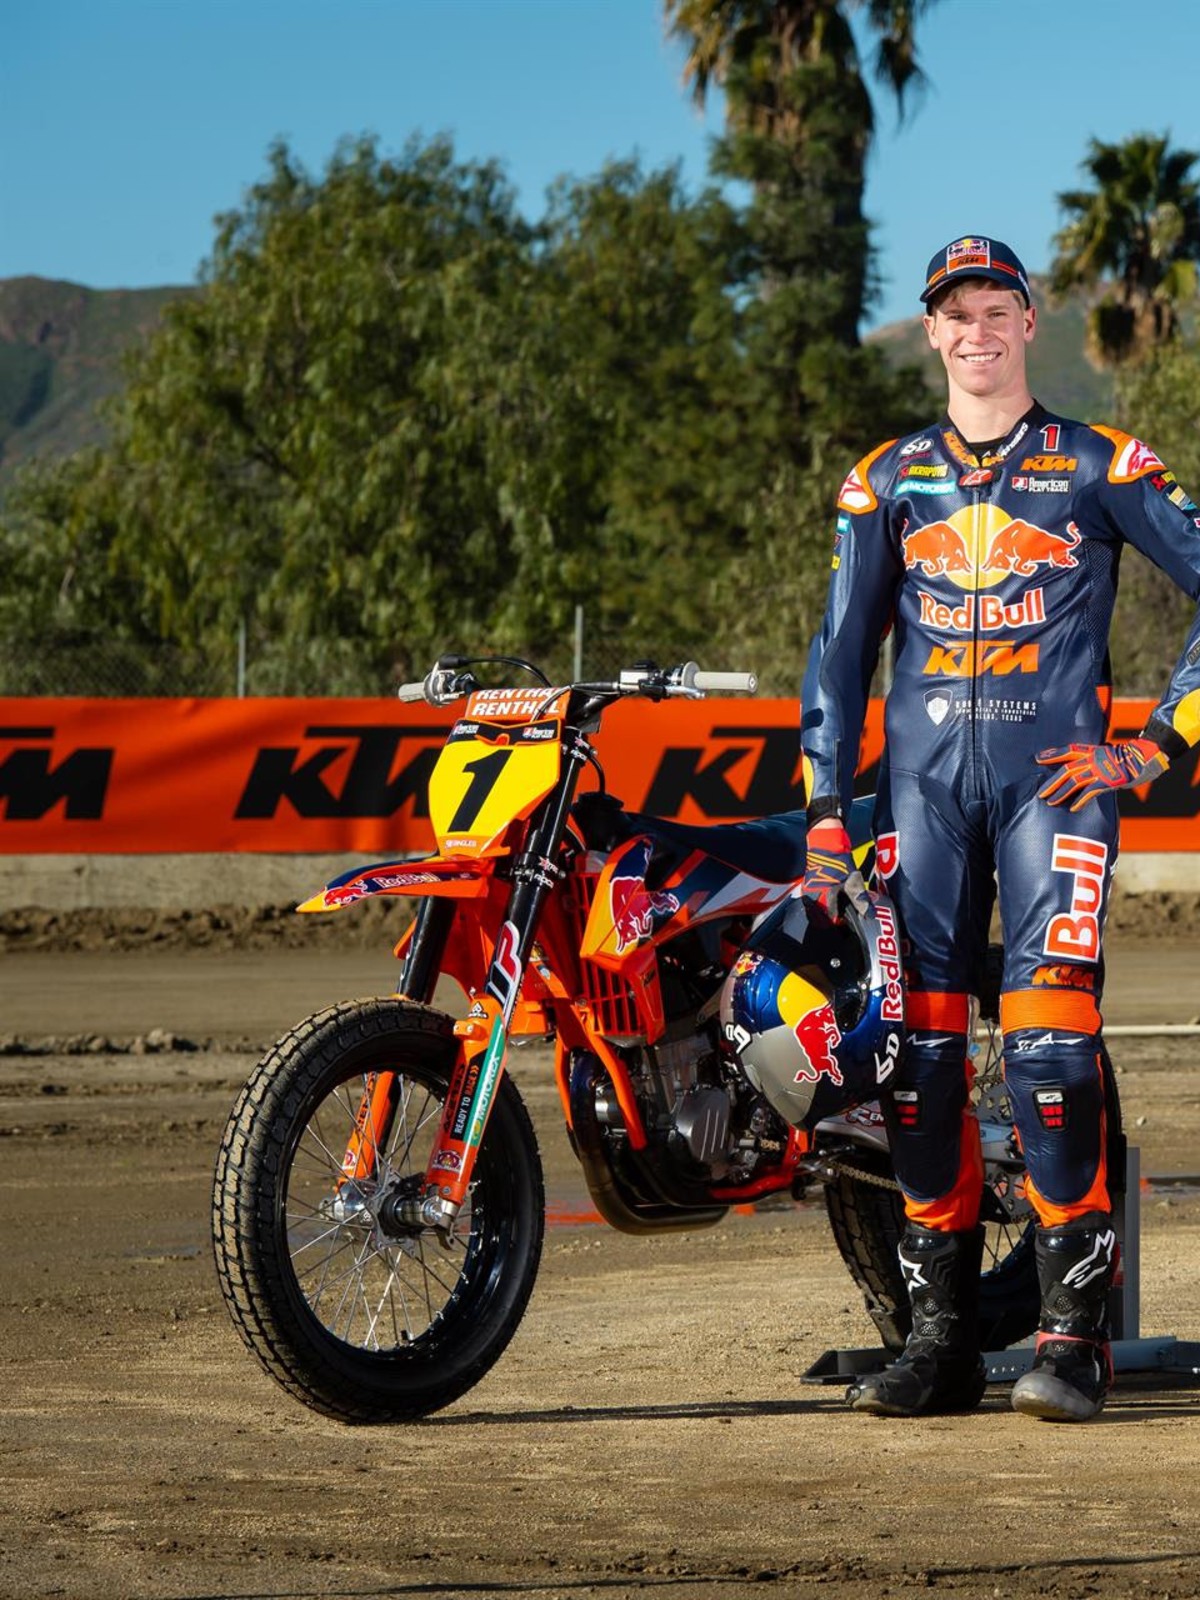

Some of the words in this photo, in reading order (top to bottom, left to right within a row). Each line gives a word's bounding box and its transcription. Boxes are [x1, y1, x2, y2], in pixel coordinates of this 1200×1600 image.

[1040, 424, 1061, 452] 1
[1021, 455, 1078, 472] KTM
[918, 590, 974, 629] Red
[979, 587, 1047, 630] Bull
[922, 640, 1039, 678] KTM
[989, 700, 1037, 710] SYSTEMS
[447, 749, 514, 833] 1
[641, 727, 803, 818] KT
[1043, 833, 1108, 963] Bull
[875, 905, 899, 958] Bull
[879, 959, 904, 1021] Red
[1032, 964, 1094, 990] KTM
[454, 1108, 468, 1134] READY
[461, 1096, 471, 1107] TO
